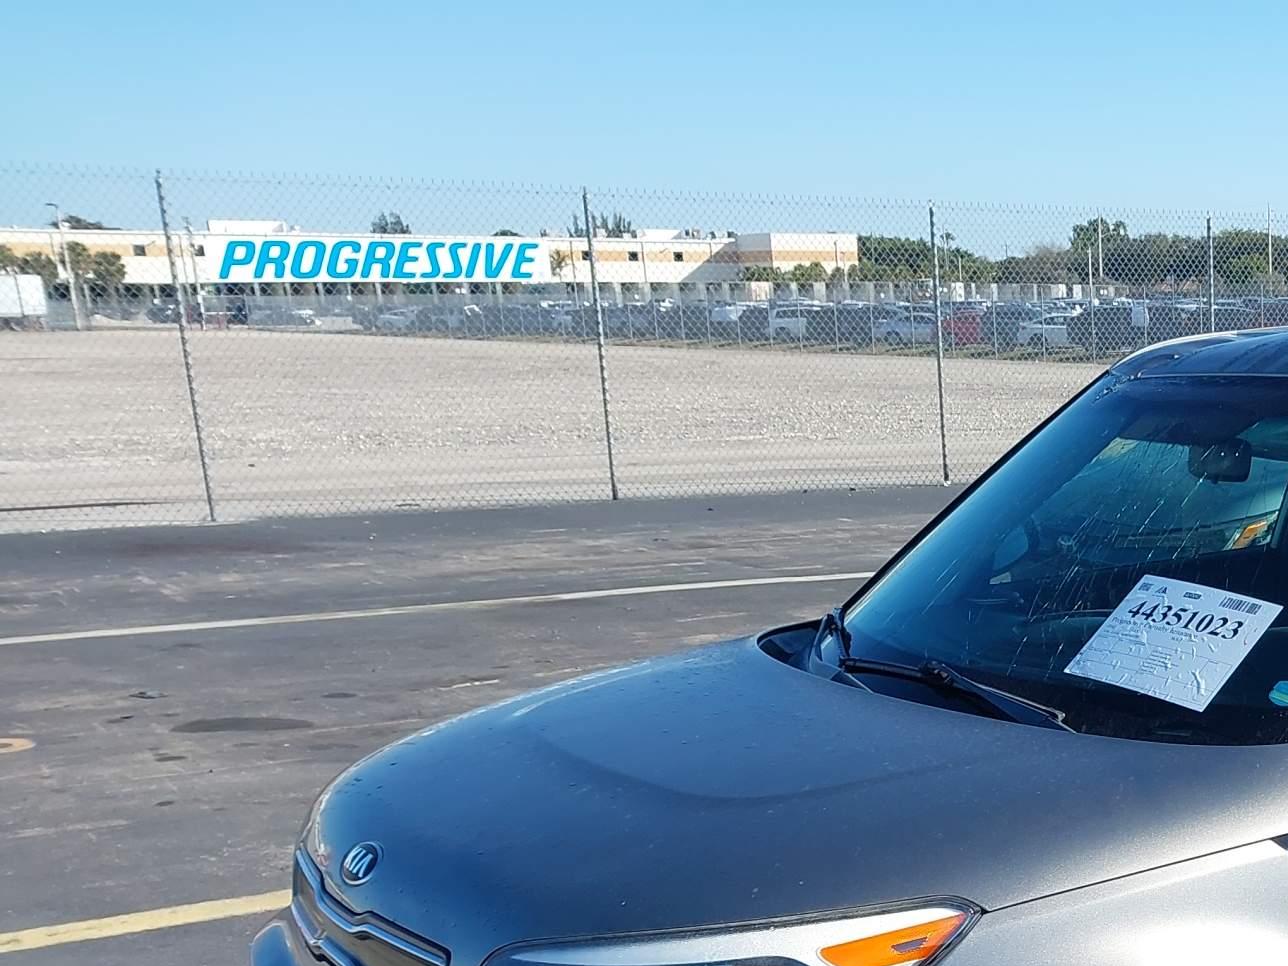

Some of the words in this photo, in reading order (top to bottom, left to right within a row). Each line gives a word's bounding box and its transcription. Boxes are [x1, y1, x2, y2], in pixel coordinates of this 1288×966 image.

[219, 240, 539, 279] PROGRESSIVE
[1128, 600, 1244, 640] 44351023
[343, 846, 374, 878] KIA
